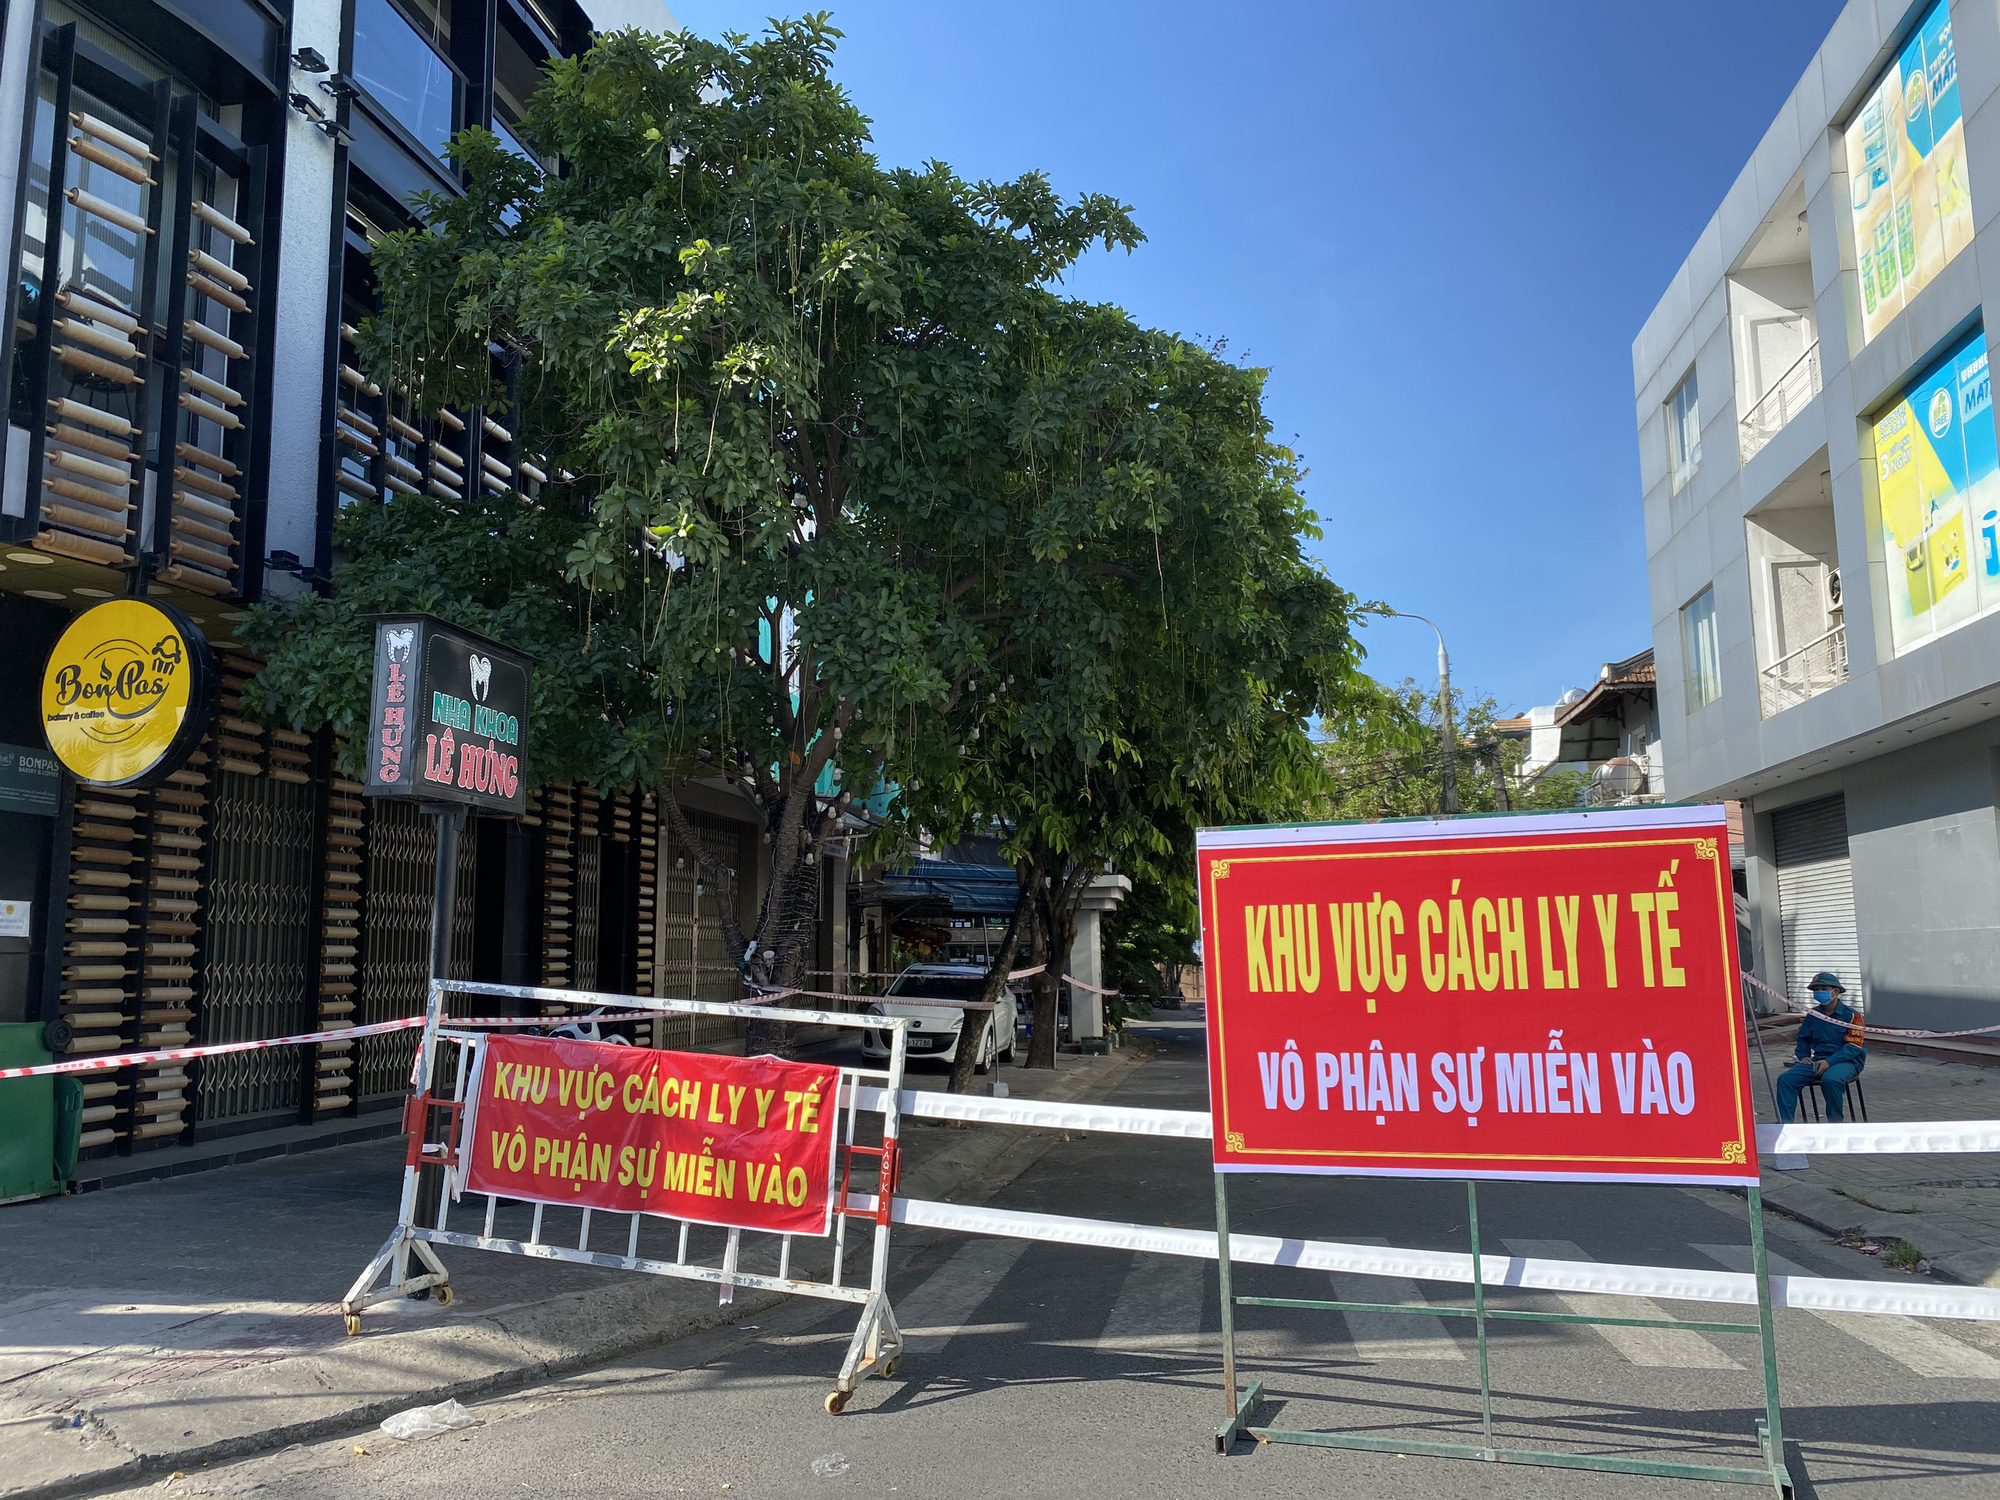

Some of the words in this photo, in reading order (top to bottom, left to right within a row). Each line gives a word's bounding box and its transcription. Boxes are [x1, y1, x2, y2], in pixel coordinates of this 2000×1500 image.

[1932, 55, 1957, 101] MAT
[1965, 376, 1992, 413] MAT
[1934, 413, 1948, 430] FREE
[1880, 452, 1890, 481] 3
[386, 663, 407, 702] LÊ
[47, 712, 73, 722] bakery
[74, 711, 79, 719] &
[80, 710, 105, 719] coffee
[432, 690, 472, 732] NHA
[474, 704, 519, 746] KHOA
[19, 756, 59, 771] BONPAS
[424, 726, 456, 785] LÊ
[457, 739, 519, 798] HƯNG
[1244, 904, 1322, 993] KHU
[1328, 891, 1407, 1013] VỰC
[1417, 879, 1530, 993] CÁCH
[1538, 895, 1580, 990] LY
[1592, 893, 1619, 989] Y
[1630, 858, 1687, 988] TẾ
[493, 1061, 551, 1105] KHU
[558, 1063, 615, 1121] VỰC
[622, 1064, 702, 1121] CÁCH
[707, 1083, 747, 1126] LY
[754, 1088, 776, 1129] Y
[784, 1075, 826, 1134] TẾ
[1257, 1038, 1306, 1112] VÔ
[1315, 1039, 1420, 1126] PHẬN
[1430, 1046, 1486, 1127] SỰ
[1493, 1029, 1602, 1115] MIỄN
[1610, 1038, 1696, 1116] VÀO
[491, 1124, 527, 1173] VÔ
[533, 1132, 612, 1193] PHẬN
[617, 1140, 661, 1199] SỰ
[663, 1136, 737, 1200] MIỄN
[745, 1152, 808, 1208] VÀO
[881, 1201, 887, 1212] 1
